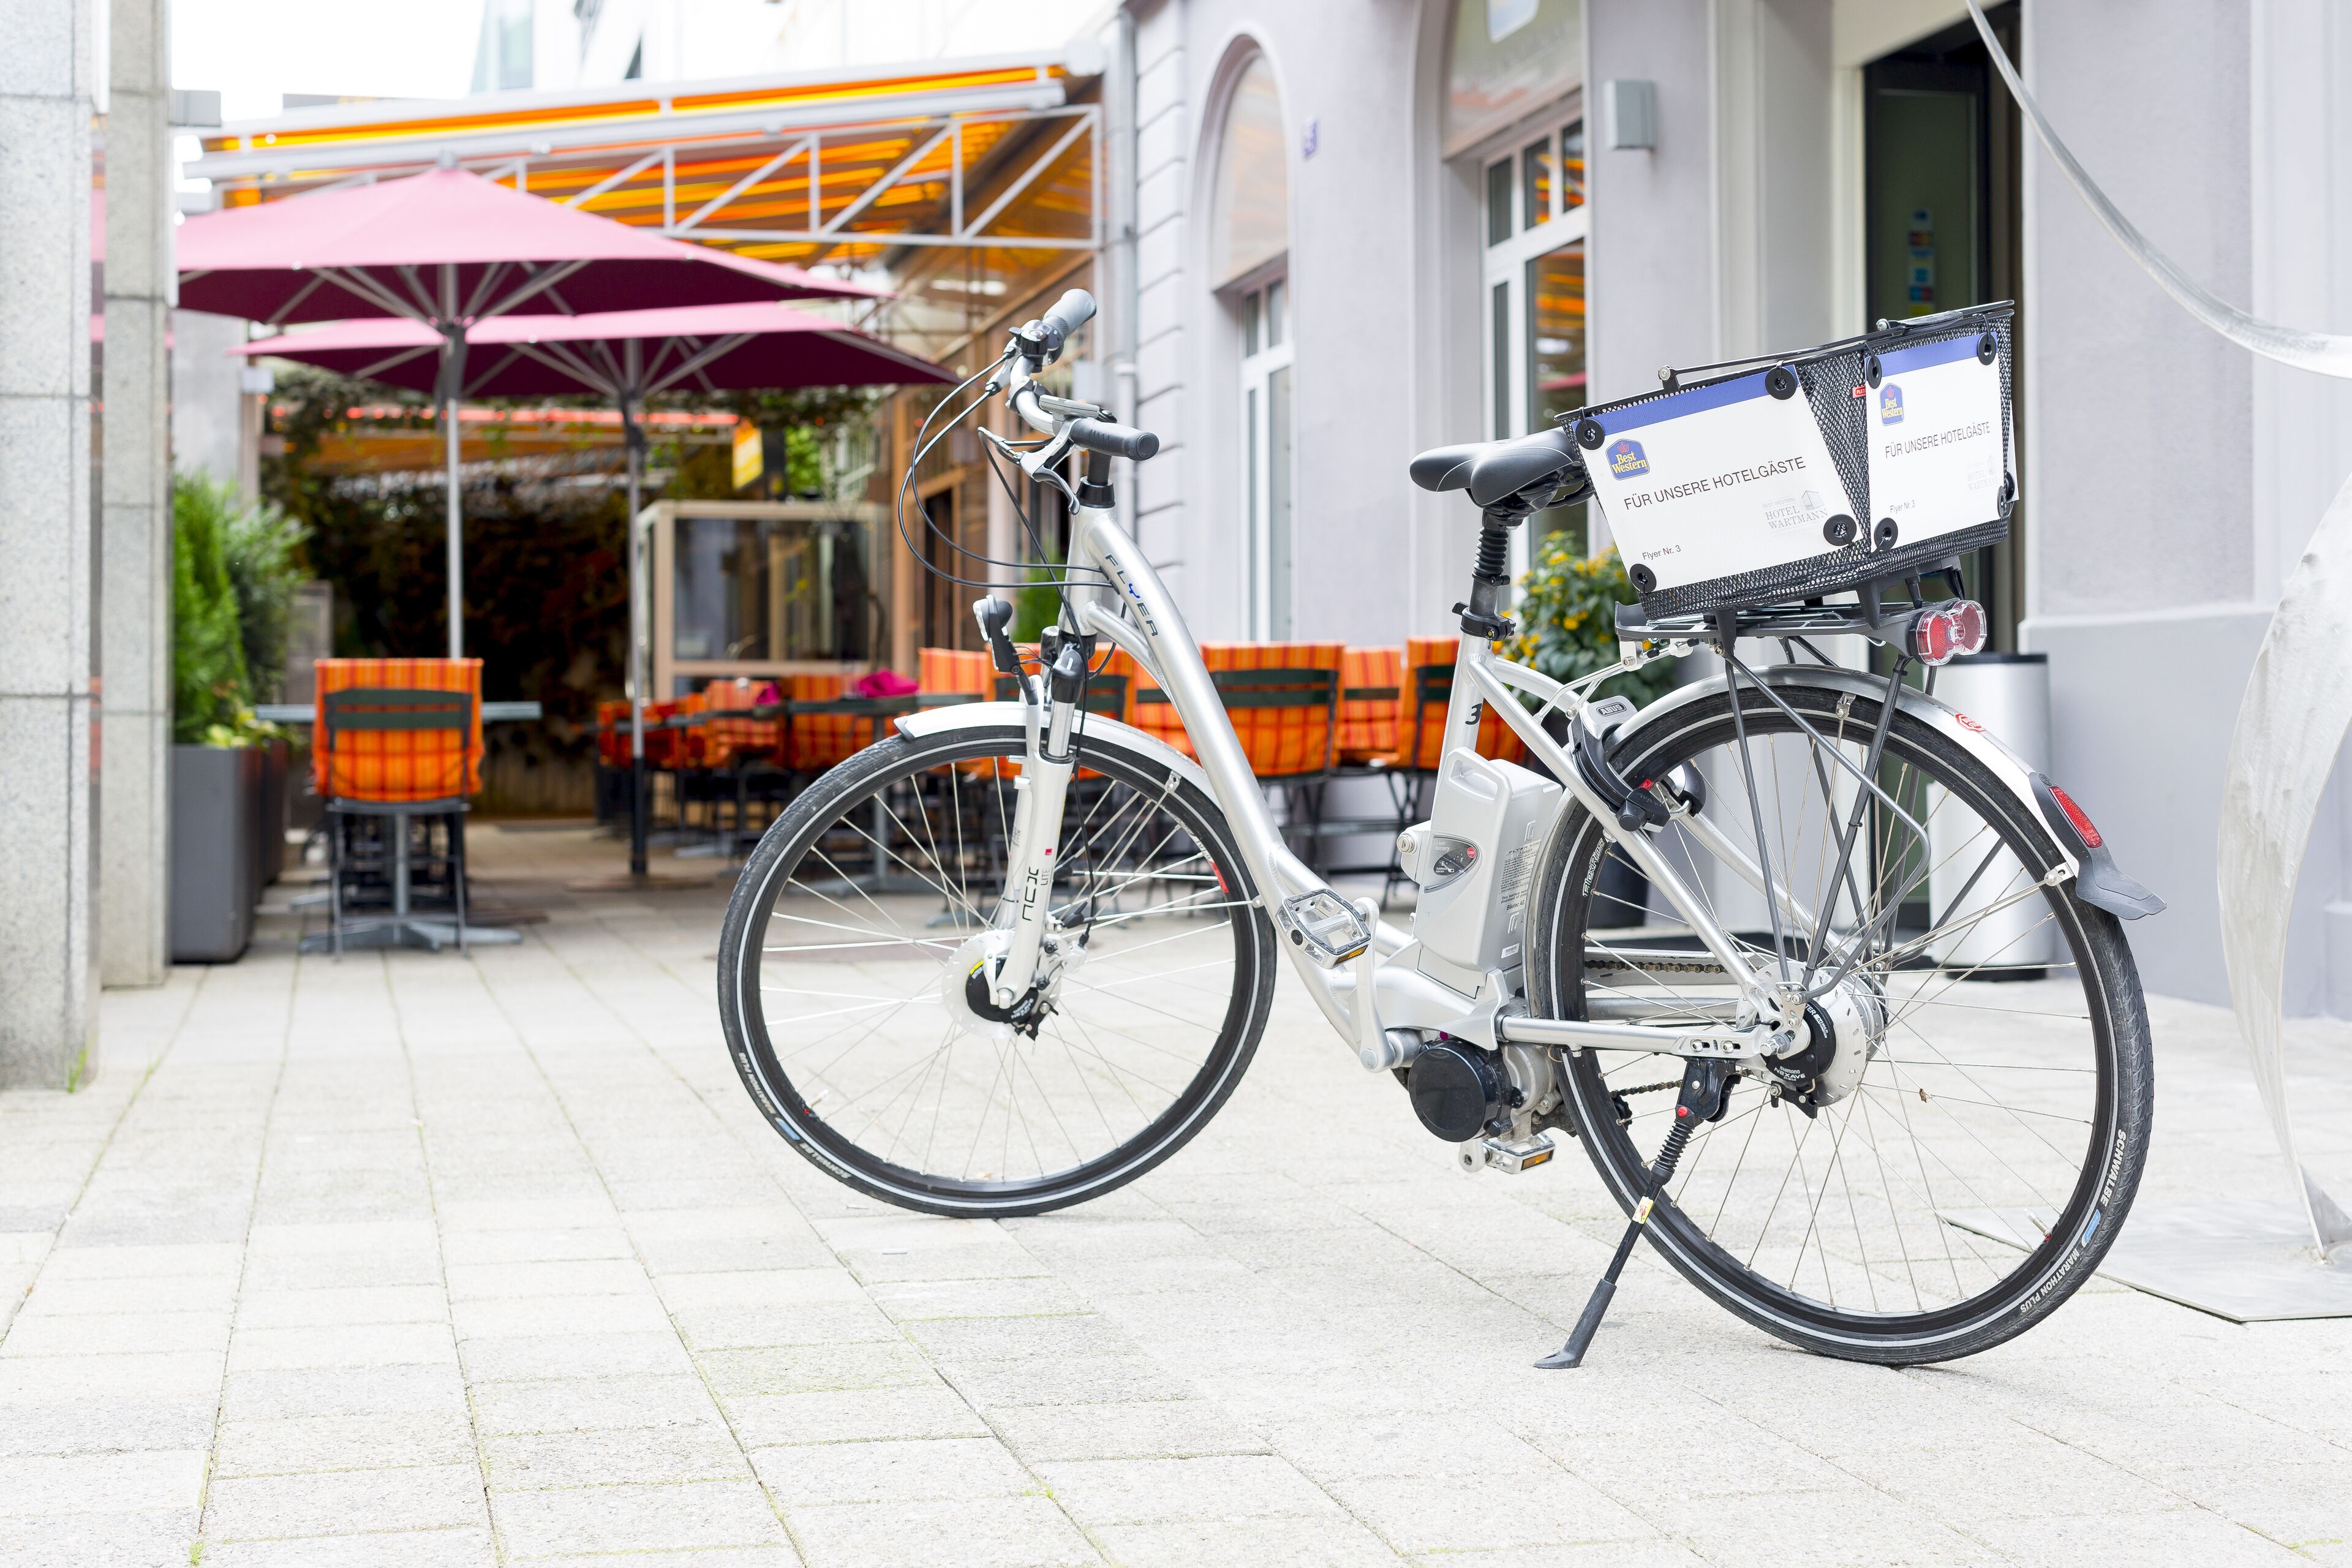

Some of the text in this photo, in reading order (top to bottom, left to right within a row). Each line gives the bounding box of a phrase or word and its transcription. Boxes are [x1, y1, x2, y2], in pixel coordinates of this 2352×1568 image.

[1885, 397, 1898, 409] Best
[1882, 407, 1903, 419] Western
[1885, 421, 1990, 458] FÜR UNSERE HOTELGÄSTE
[1616, 451, 1636, 464] Best
[1611, 459, 1648, 474] Western
[1624, 456, 1806, 510] FÜR UNSERE HOTELGÄSTE
[1765, 506, 1800, 520] HOTEL
[1890, 505, 1903, 514] Flyer
[1768, 508, 1828, 529] WARTMANN
[1642, 551, 1661, 560] Flyer
[1105, 554, 1158, 636] FLYER
[1464, 703, 1482, 725] 3
[1600, 703, 1623, 715] ABUS
[1041, 867, 1050, 886] LITE
[739, 1052, 752, 1072] PLUS
[1779, 1066, 1801, 1074] SHIMANO
[1774, 1067, 1806, 1079] NEXAVE
[799, 1142, 852, 1179] SCHWALBE
[2100, 1129, 2127, 1207] SCHWALBE
[2019, 1248, 2080, 1313] MARATHON PLUS
